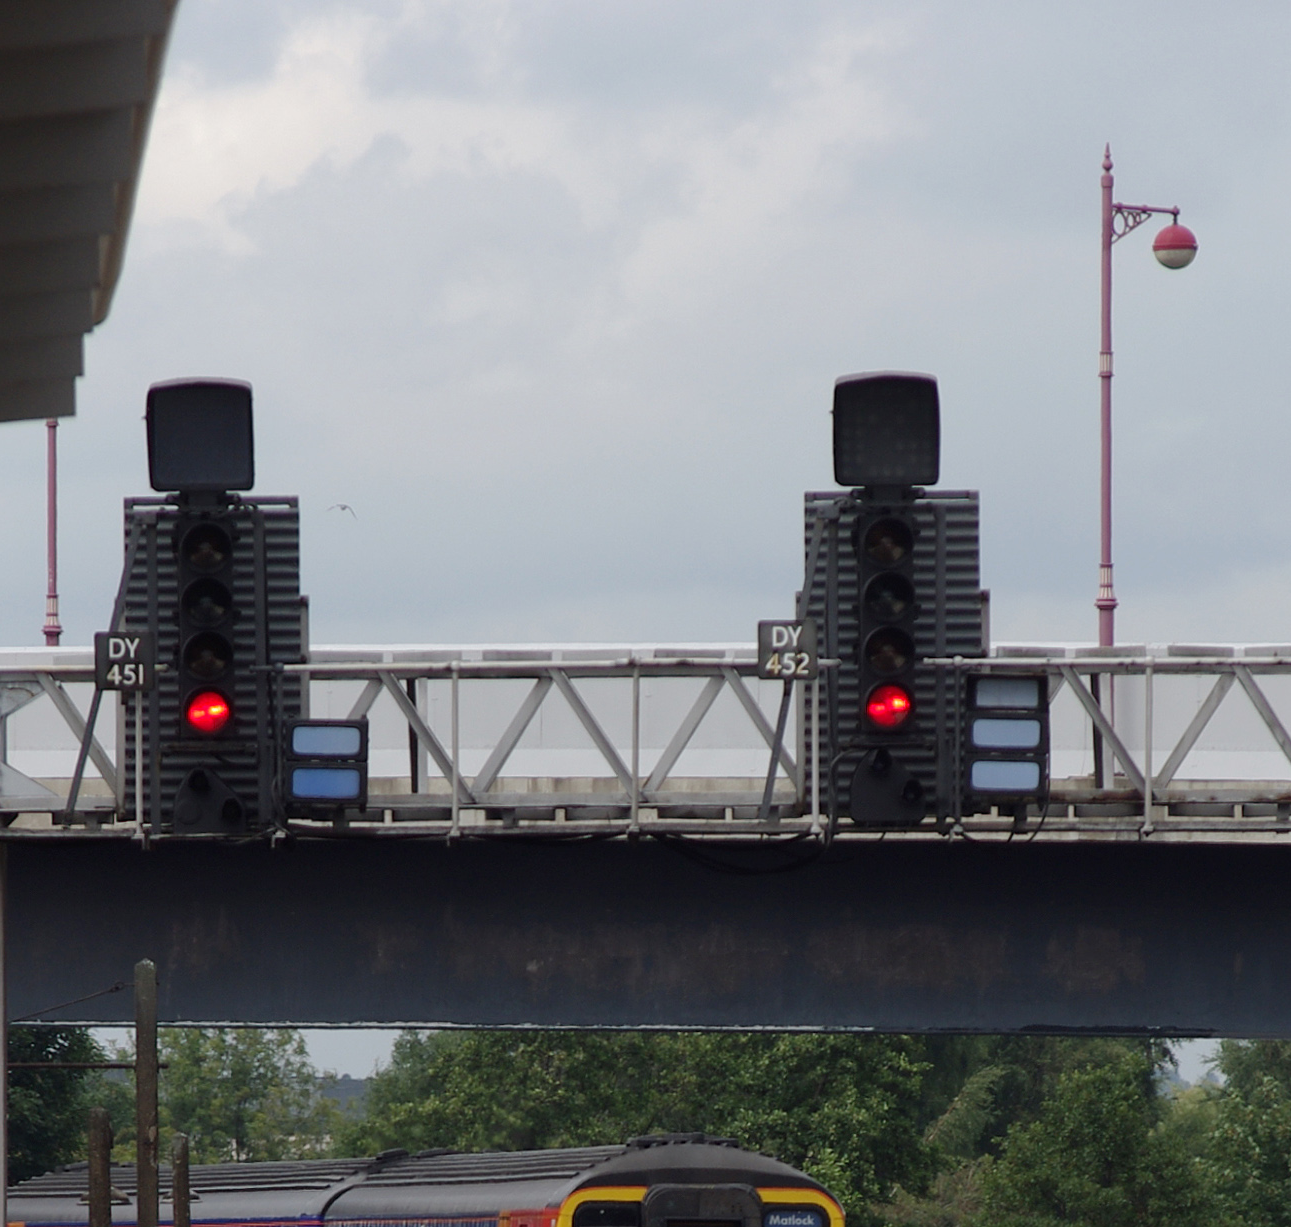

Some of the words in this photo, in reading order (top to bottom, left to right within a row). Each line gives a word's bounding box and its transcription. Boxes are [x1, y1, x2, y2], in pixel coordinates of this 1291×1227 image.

[772, 626, 803, 647] DY
[109, 638, 140, 658] DY
[766, 651, 810, 675] 452
[107, 664, 143, 685] 451
[769, 1215, 815, 1226] Matlock
